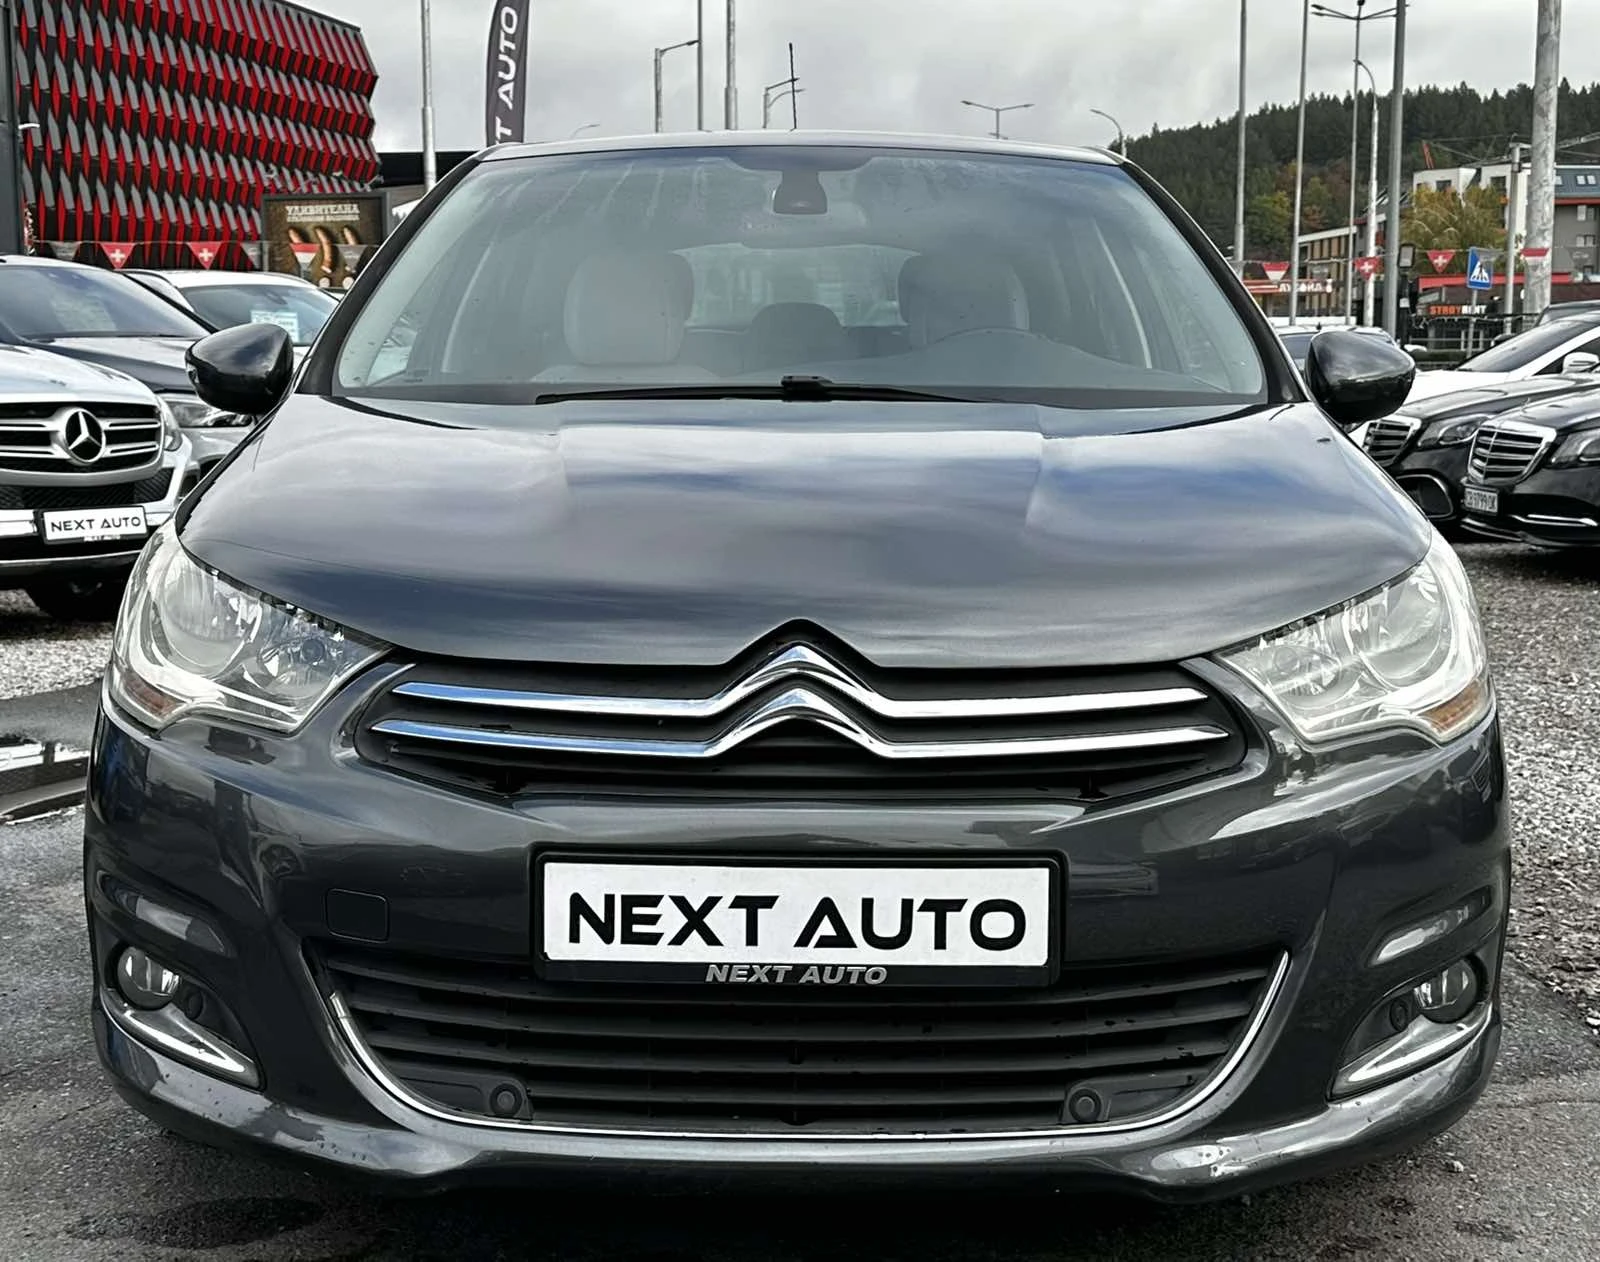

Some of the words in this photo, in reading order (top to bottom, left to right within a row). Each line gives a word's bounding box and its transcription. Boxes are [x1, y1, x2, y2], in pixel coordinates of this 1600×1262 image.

[497, 6, 518, 110] AUTO
[51, 518, 95, 532] NEXT
[101, 516, 141, 529] AUTO
[569, 892, 780, 947] NEXT
[793, 896, 1027, 951] AUTO
[705, 964, 793, 983] NEXT
[799, 966, 888, 985] AUTO
